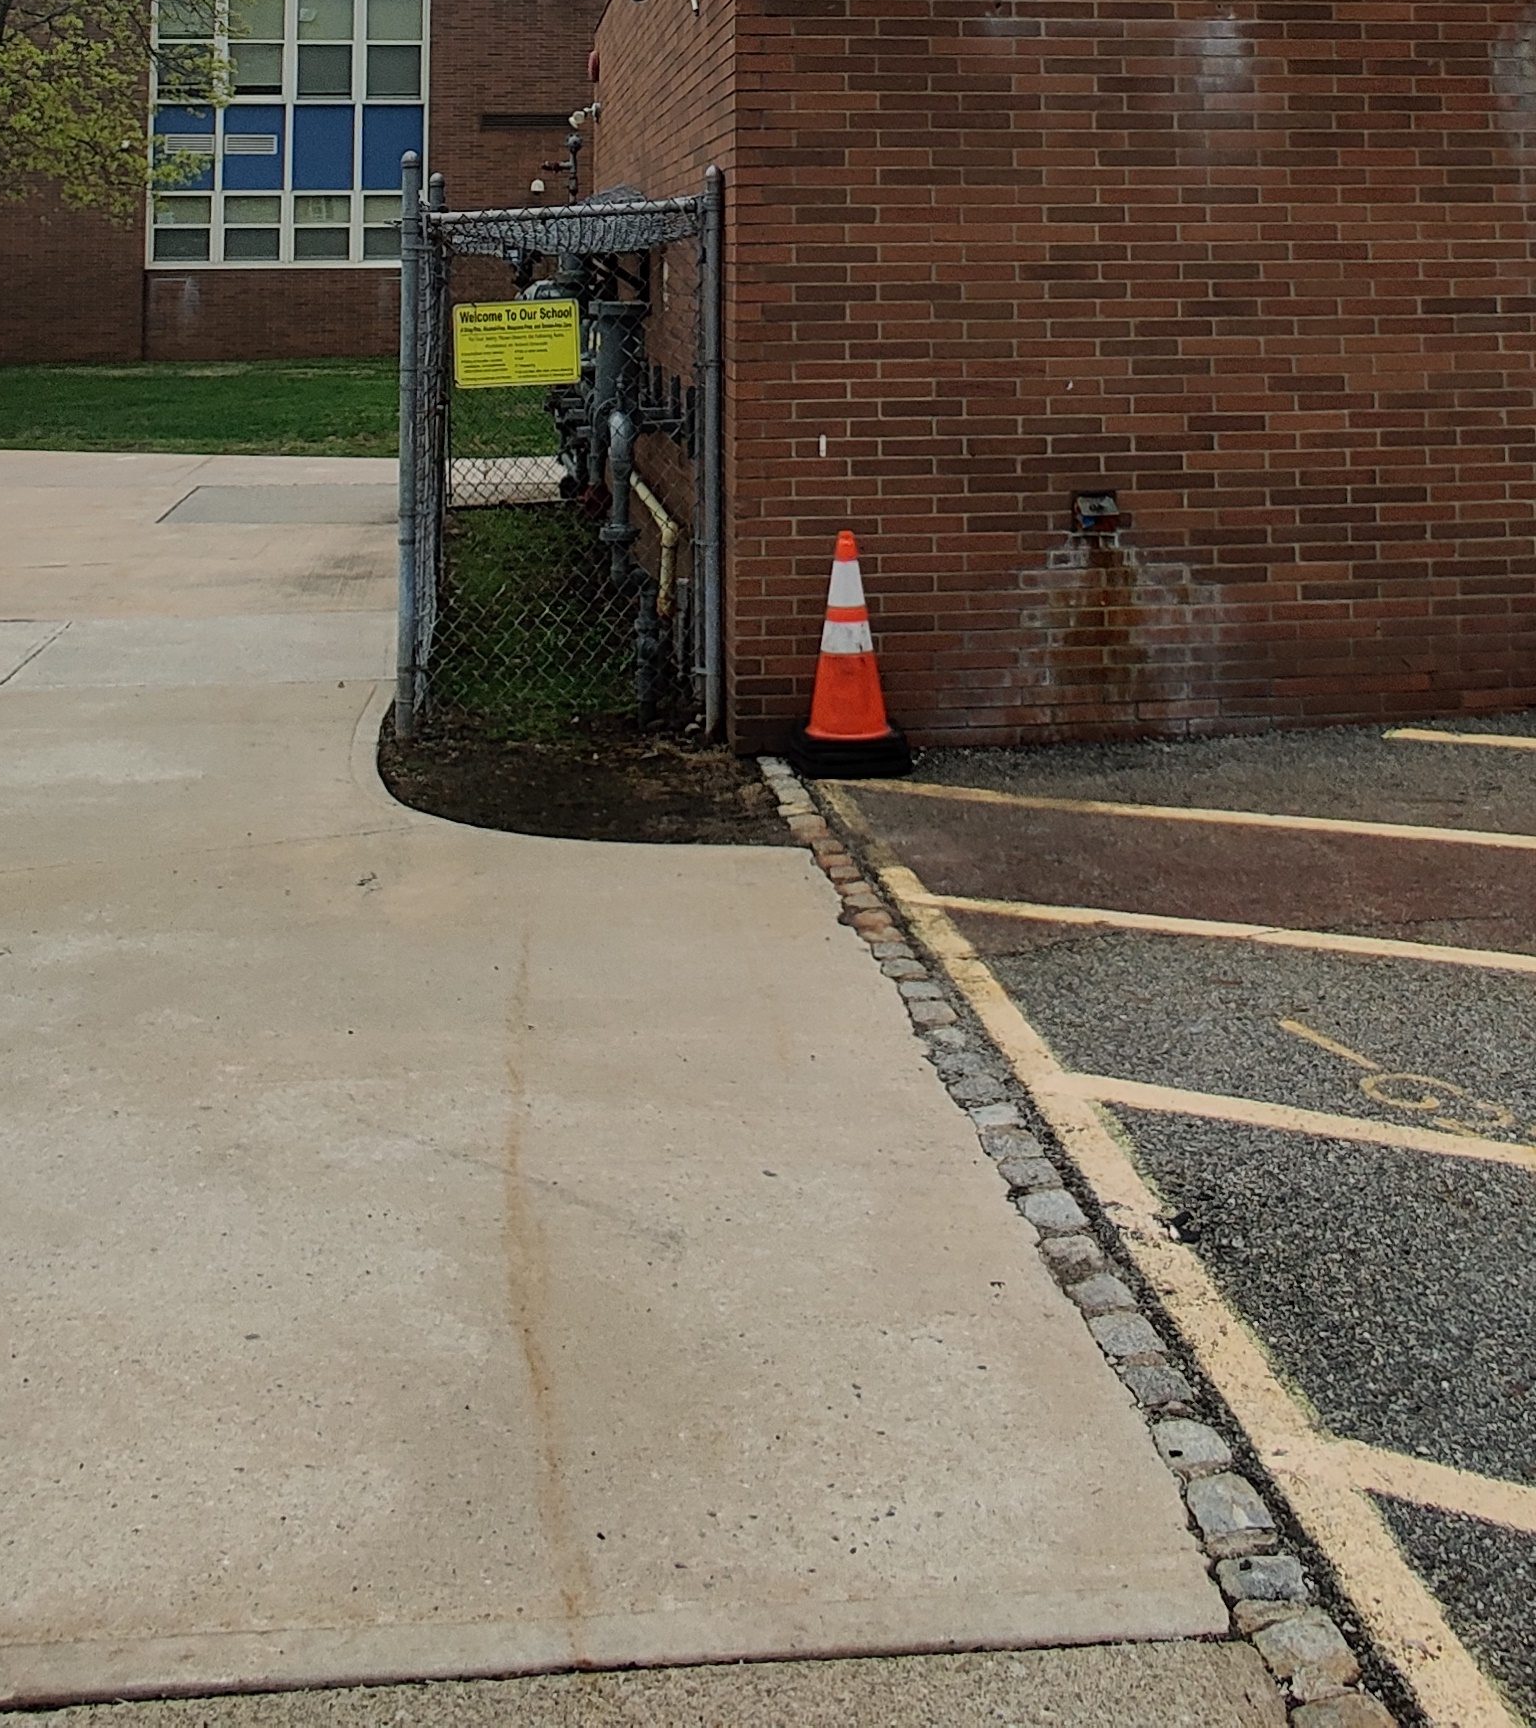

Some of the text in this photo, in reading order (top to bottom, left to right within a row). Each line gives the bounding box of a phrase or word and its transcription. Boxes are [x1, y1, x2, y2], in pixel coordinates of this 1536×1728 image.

[459, 306, 572, 323] Welcome To Our School
